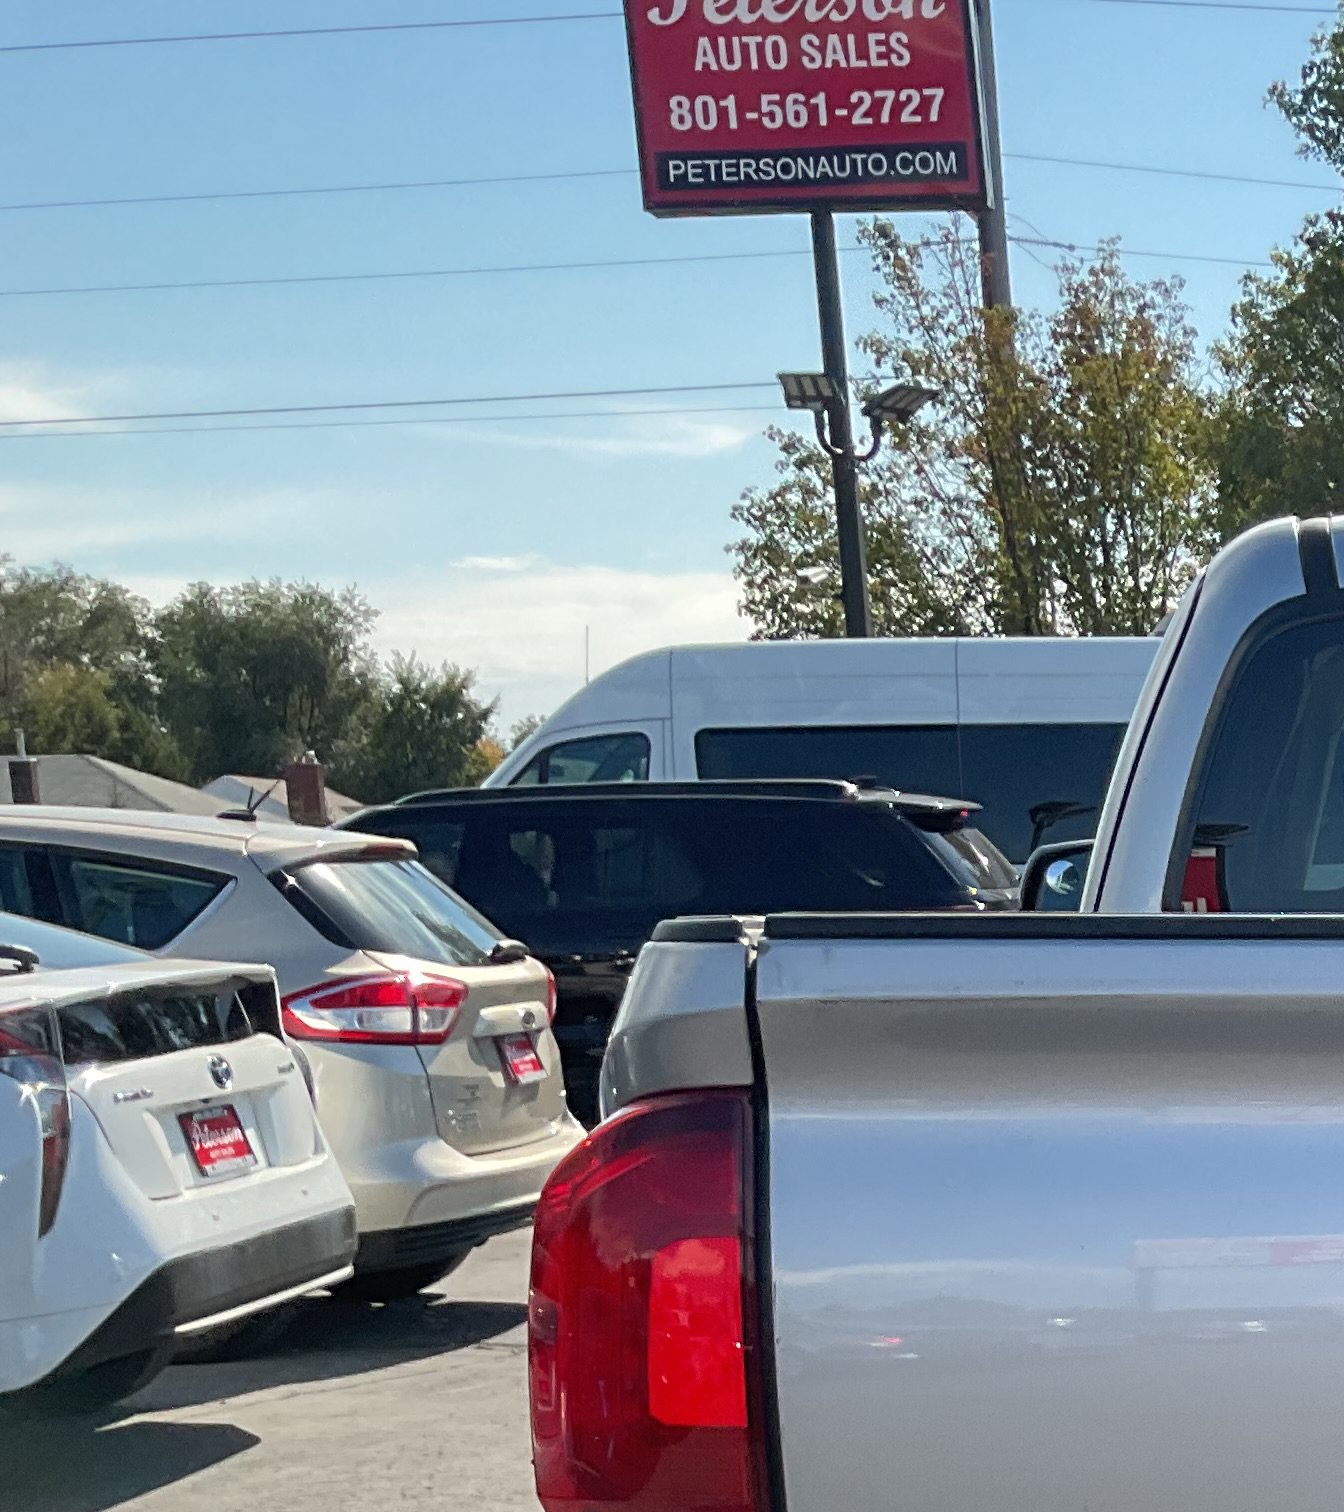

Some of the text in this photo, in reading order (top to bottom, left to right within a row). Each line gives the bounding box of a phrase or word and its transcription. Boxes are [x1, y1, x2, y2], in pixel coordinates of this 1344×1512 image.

[694, 33, 911, 72] AUTO SALES
[669, 88, 946, 131] 801-561-2727
[668, 151, 958, 183] PETERSONAUTO.COM
